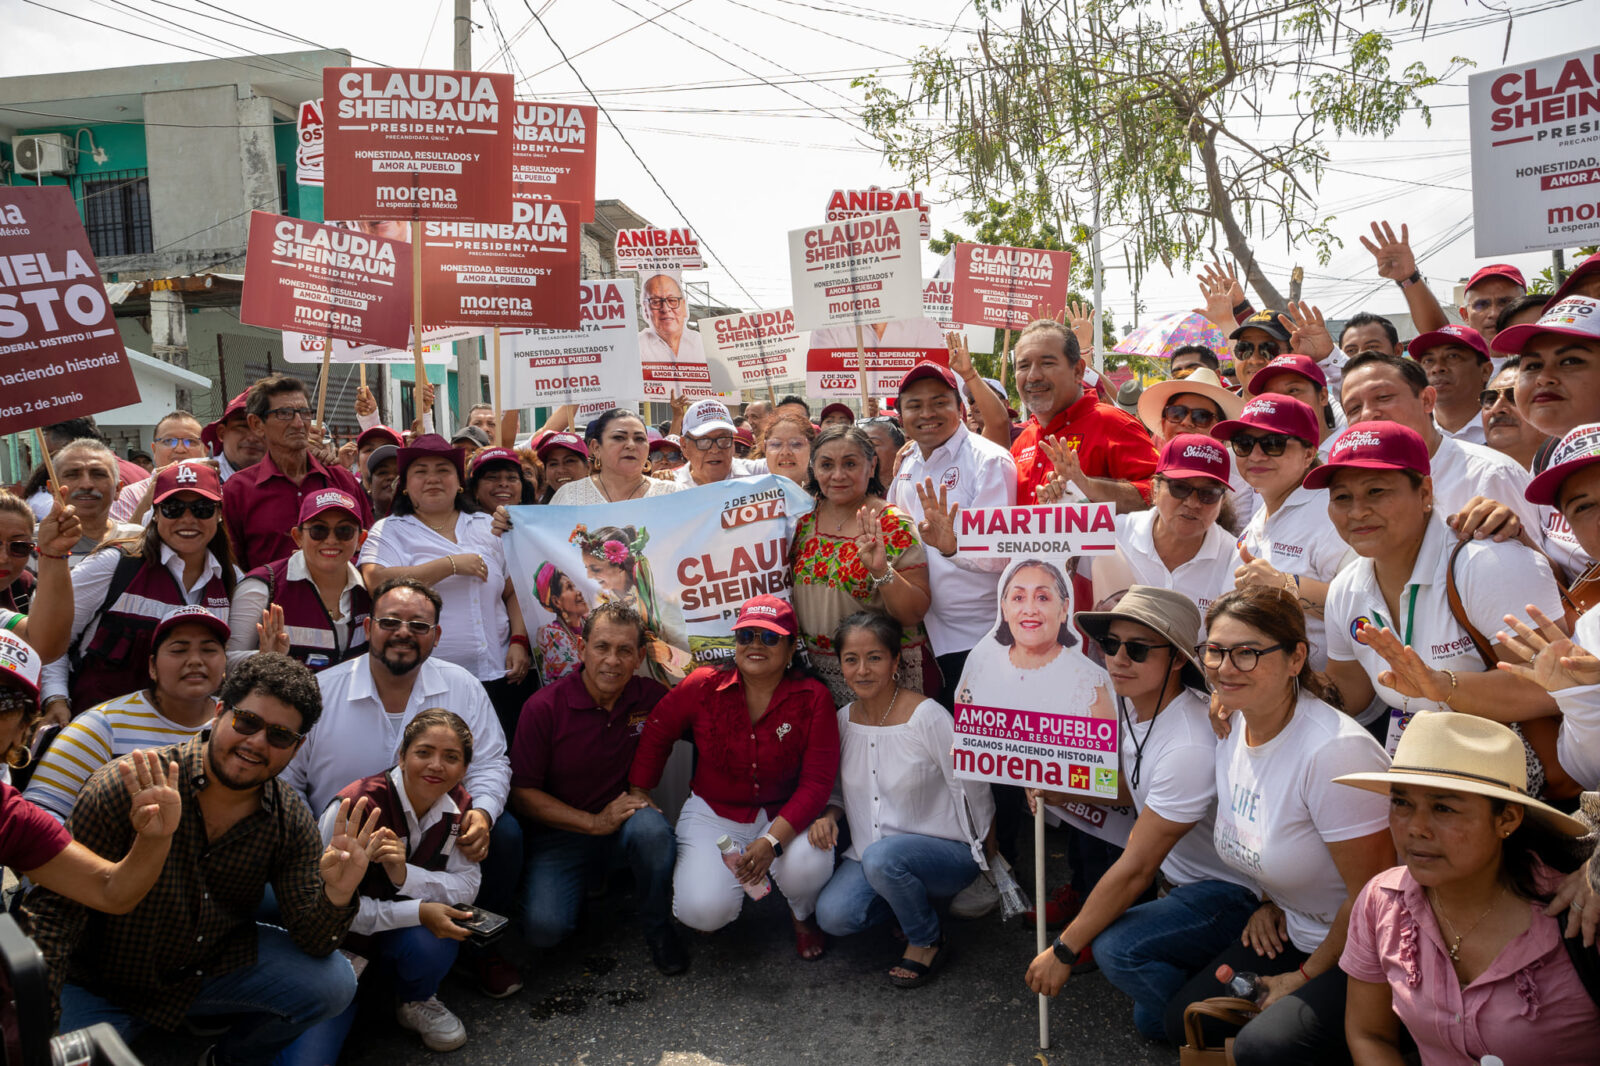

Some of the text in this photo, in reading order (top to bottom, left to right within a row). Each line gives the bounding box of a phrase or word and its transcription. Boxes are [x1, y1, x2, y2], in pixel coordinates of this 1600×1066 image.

[339, 73, 499, 103] CLAUDIA
[338, 99, 499, 123] SHEINBAUM
[513, 105, 586, 129] UDIA
[1490, 89, 1600, 133] SHEIN
[371, 123, 465, 135] PRESIDENTA
[1537, 124, 1600, 142] PRESI
[1559, 135, 1600, 147] PRECAND
[355, 150, 481, 163] HONESTIDAD, RESULTADOS Y
[379, 162, 456, 174] AMOR AL PUEBLO
[521, 165, 564, 174] RESULTADOS
[1516, 157, 1600, 178] HONESTIDAD,
[1550, 175, 1588, 188] AMOR
[376, 186, 459, 203] morena
[828, 187, 929, 212] ANÍBAL
[386, 202, 420, 210] esperanza
[421, 202, 432, 210] de
[432, 201, 459, 210] México
[425, 220, 568, 244] SHEINBAUM
[804, 217, 900, 250] CLAUDIA
[1548, 226, 1557, 234] La
[274, 221, 396, 263] CLAUDIA
[455, 241, 539, 252] PRESIDENTA
[617, 226, 699, 252] ANÍBAL
[618, 247, 699, 257] OSTOA ORTEGA
[805, 236, 901, 264] SHEINBAUM
[970, 248, 1053, 269] CLAUDIA
[272, 242, 396, 278] SHEINBAUM
[638, 264, 681, 273] SENADOR
[824, 256, 881, 271] PRESIDENTA
[298, 262, 370, 284] PRESIDENTA
[441, 264, 495, 274] HONESTIDAD,
[495, 266, 544, 275] RESULTADOS
[969, 263, 1053, 281] SHEINBAUM
[463, 275, 531, 284] AMOR AL PUEBLO
[814, 278, 850, 289] HONESTIDAD,
[850, 274, 889, 285] RESULTADOS
[923, 281, 954, 294] AU
[985, 276, 1034, 287] PRESIDENTA
[279, 277, 329, 295] HONESTIDAD,
[329, 283, 376, 303] RESULTADOS
[376, 293, 383, 303] Y
[299, 291, 363, 309] AMOR AL PUEBLO
[460, 295, 533, 312] morena
[829, 297, 881, 314] morena
[295, 305, 362, 328] morena
[470, 309, 500, 317] esperanza
[511, 309, 533, 317] México
[715, 309, 795, 333] CLAUDIA
[984, 307, 1029, 321] morena
[40, 332, 84, 350] DISTRITO
[735, 337, 783, 349] PRESIDENTA
[514, 349, 563, 359] HONESTIDAD,
[564, 346, 608, 356] RESULTADOS
[534, 355, 597, 367] AMOR AL PUEBLO
[66, 351, 120, 374] historia!
[742, 366, 787, 381] morena
[535, 375, 601, 392] morena
[536, 389, 544, 397] La
[545, 387, 572, 397] esperanza
[821, 380, 856, 388] VOTA
[24, 391, 83, 413] 2 de Junio
[580, 400, 617, 414] morena
[176, 465, 198, 483] LA
[725, 501, 731, 509] 2
[732, 497, 748, 508] DE
[723, 504, 784, 529] VOTA
[962, 505, 1116, 535] MARTINA
[997, 541, 1071, 553] SENADORA
[1274, 542, 1304, 554] morena
[1431, 635, 1473, 655] morena
[958, 708, 1113, 742] AMOR AL PUEBLO
[955, 723, 1114, 751] HONESTIDAD, RESULTADOS Y
[962, 738, 1105, 766] SIGAMOS HACIENDO HISTORIA
[954, 748, 1064, 786] morena
[1070, 773, 1089, 788] PT
[1061, 800, 1103, 824] EBLO
